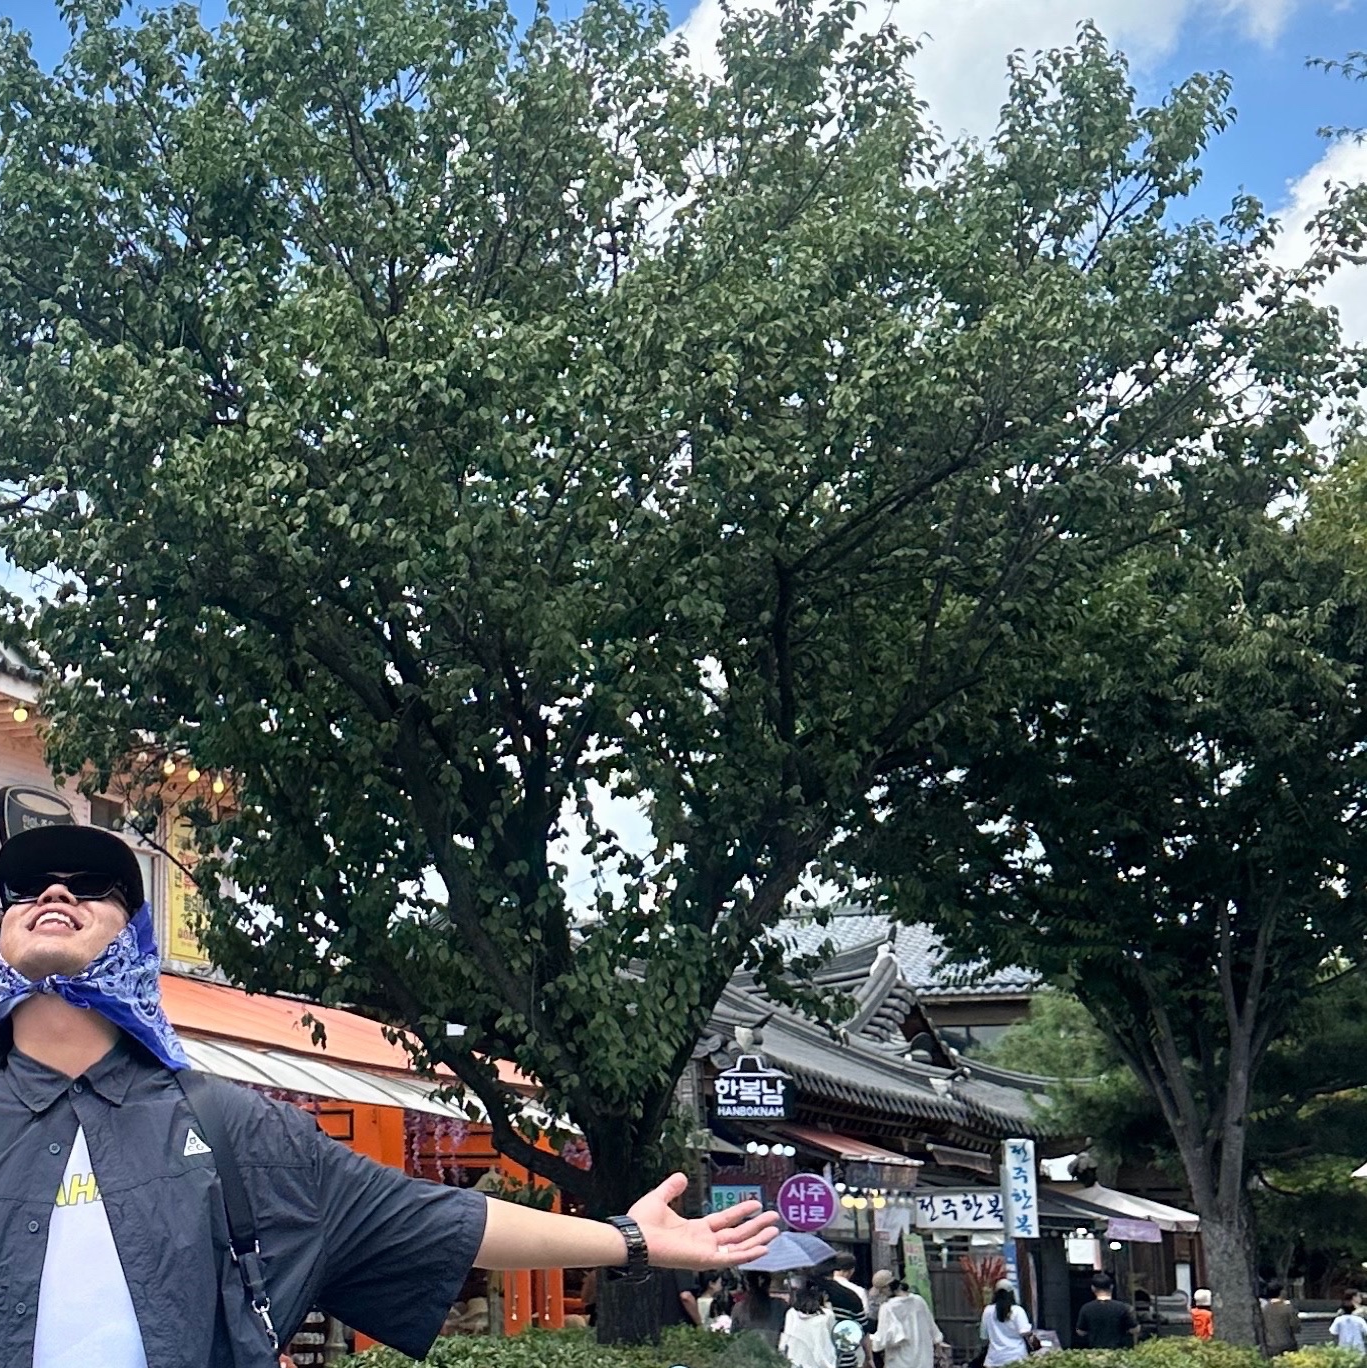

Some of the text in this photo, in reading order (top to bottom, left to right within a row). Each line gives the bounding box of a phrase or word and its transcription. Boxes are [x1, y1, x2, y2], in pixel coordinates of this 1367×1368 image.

[714, 1078, 786, 1105] 한복남
[717, 1106, 785, 1117] HANBOKNAM
[787, 1182, 826, 1202] 사주
[788, 1204, 827, 1224] 타로
